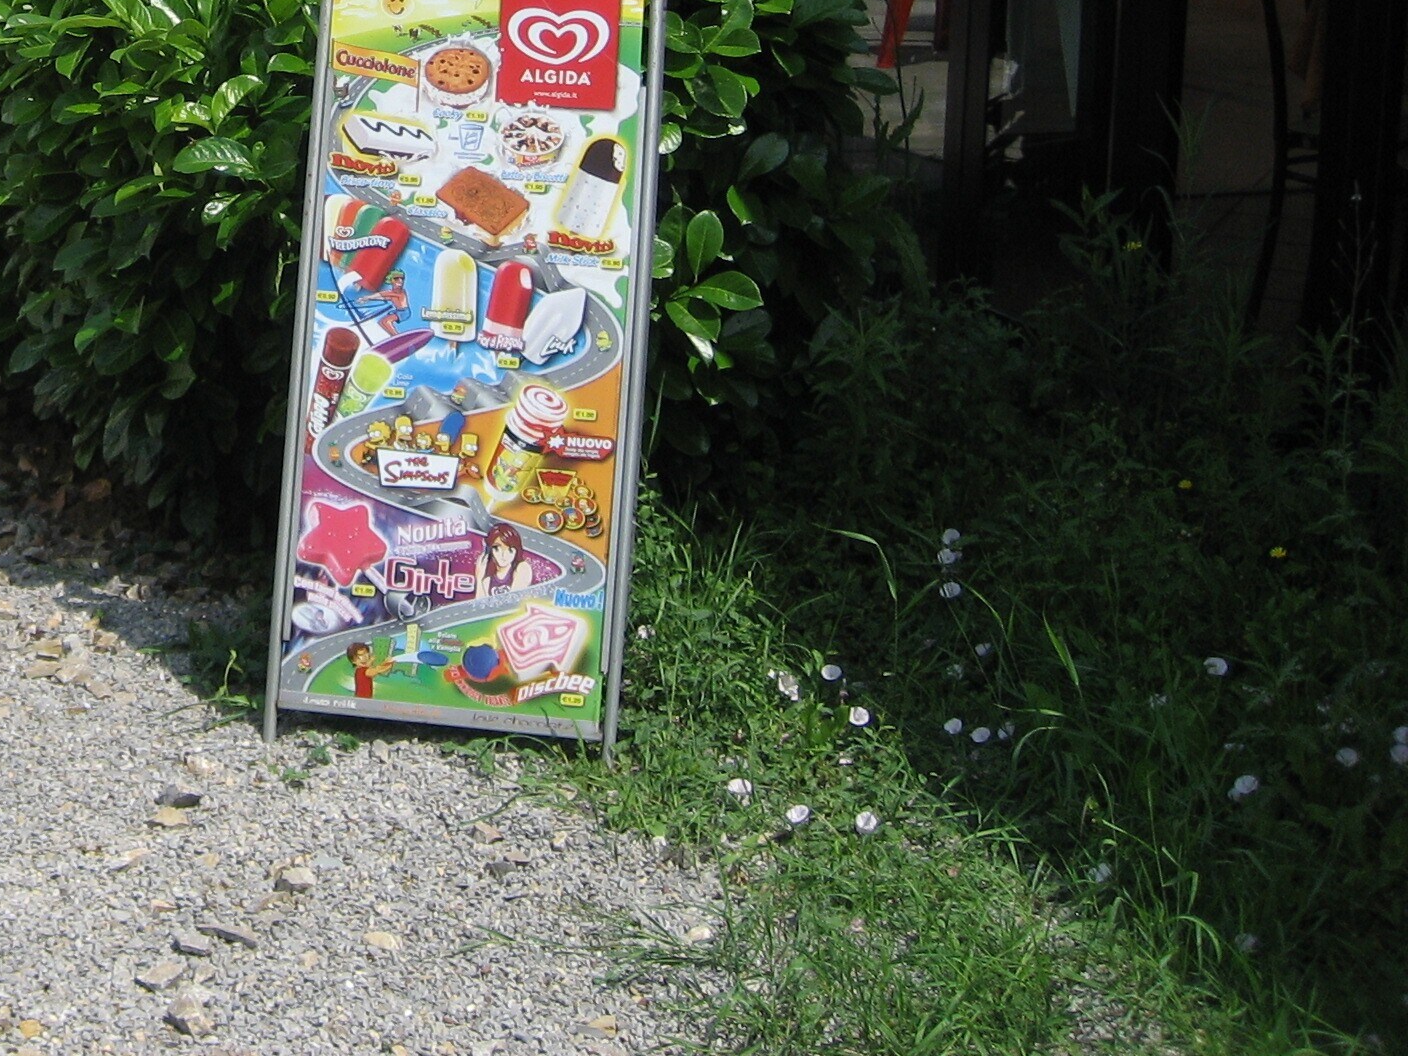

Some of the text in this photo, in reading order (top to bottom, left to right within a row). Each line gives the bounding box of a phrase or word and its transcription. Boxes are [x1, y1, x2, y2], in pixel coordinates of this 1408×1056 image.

[336, 49, 416, 79] Cucciolone
[520, 68, 591, 86] ALGIDA
[567, 437, 612, 450] NUOVO
[397, 515, 468, 544] Novità
